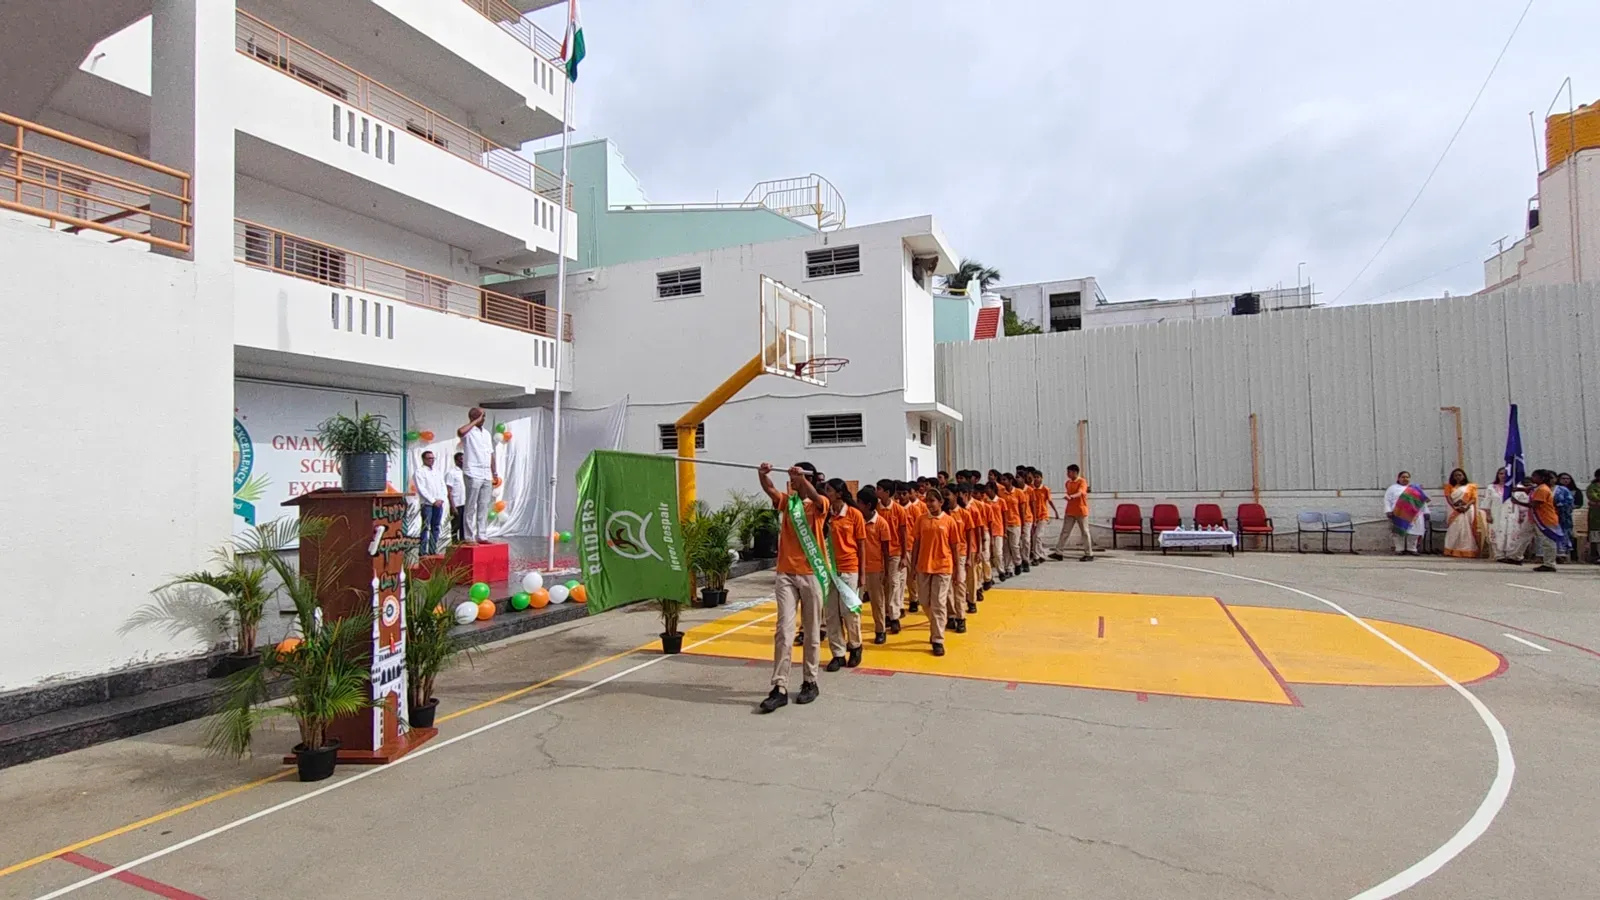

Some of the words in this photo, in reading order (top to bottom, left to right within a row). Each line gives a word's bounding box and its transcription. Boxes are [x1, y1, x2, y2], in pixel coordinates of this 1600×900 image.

[234, 425, 251, 485] EXCELLENCE
[373, 498, 405, 522] Happy
[658, 501, 674, 544] Despair
[582, 499, 602, 575] RAIDERS
[667, 544, 682, 571] Never
